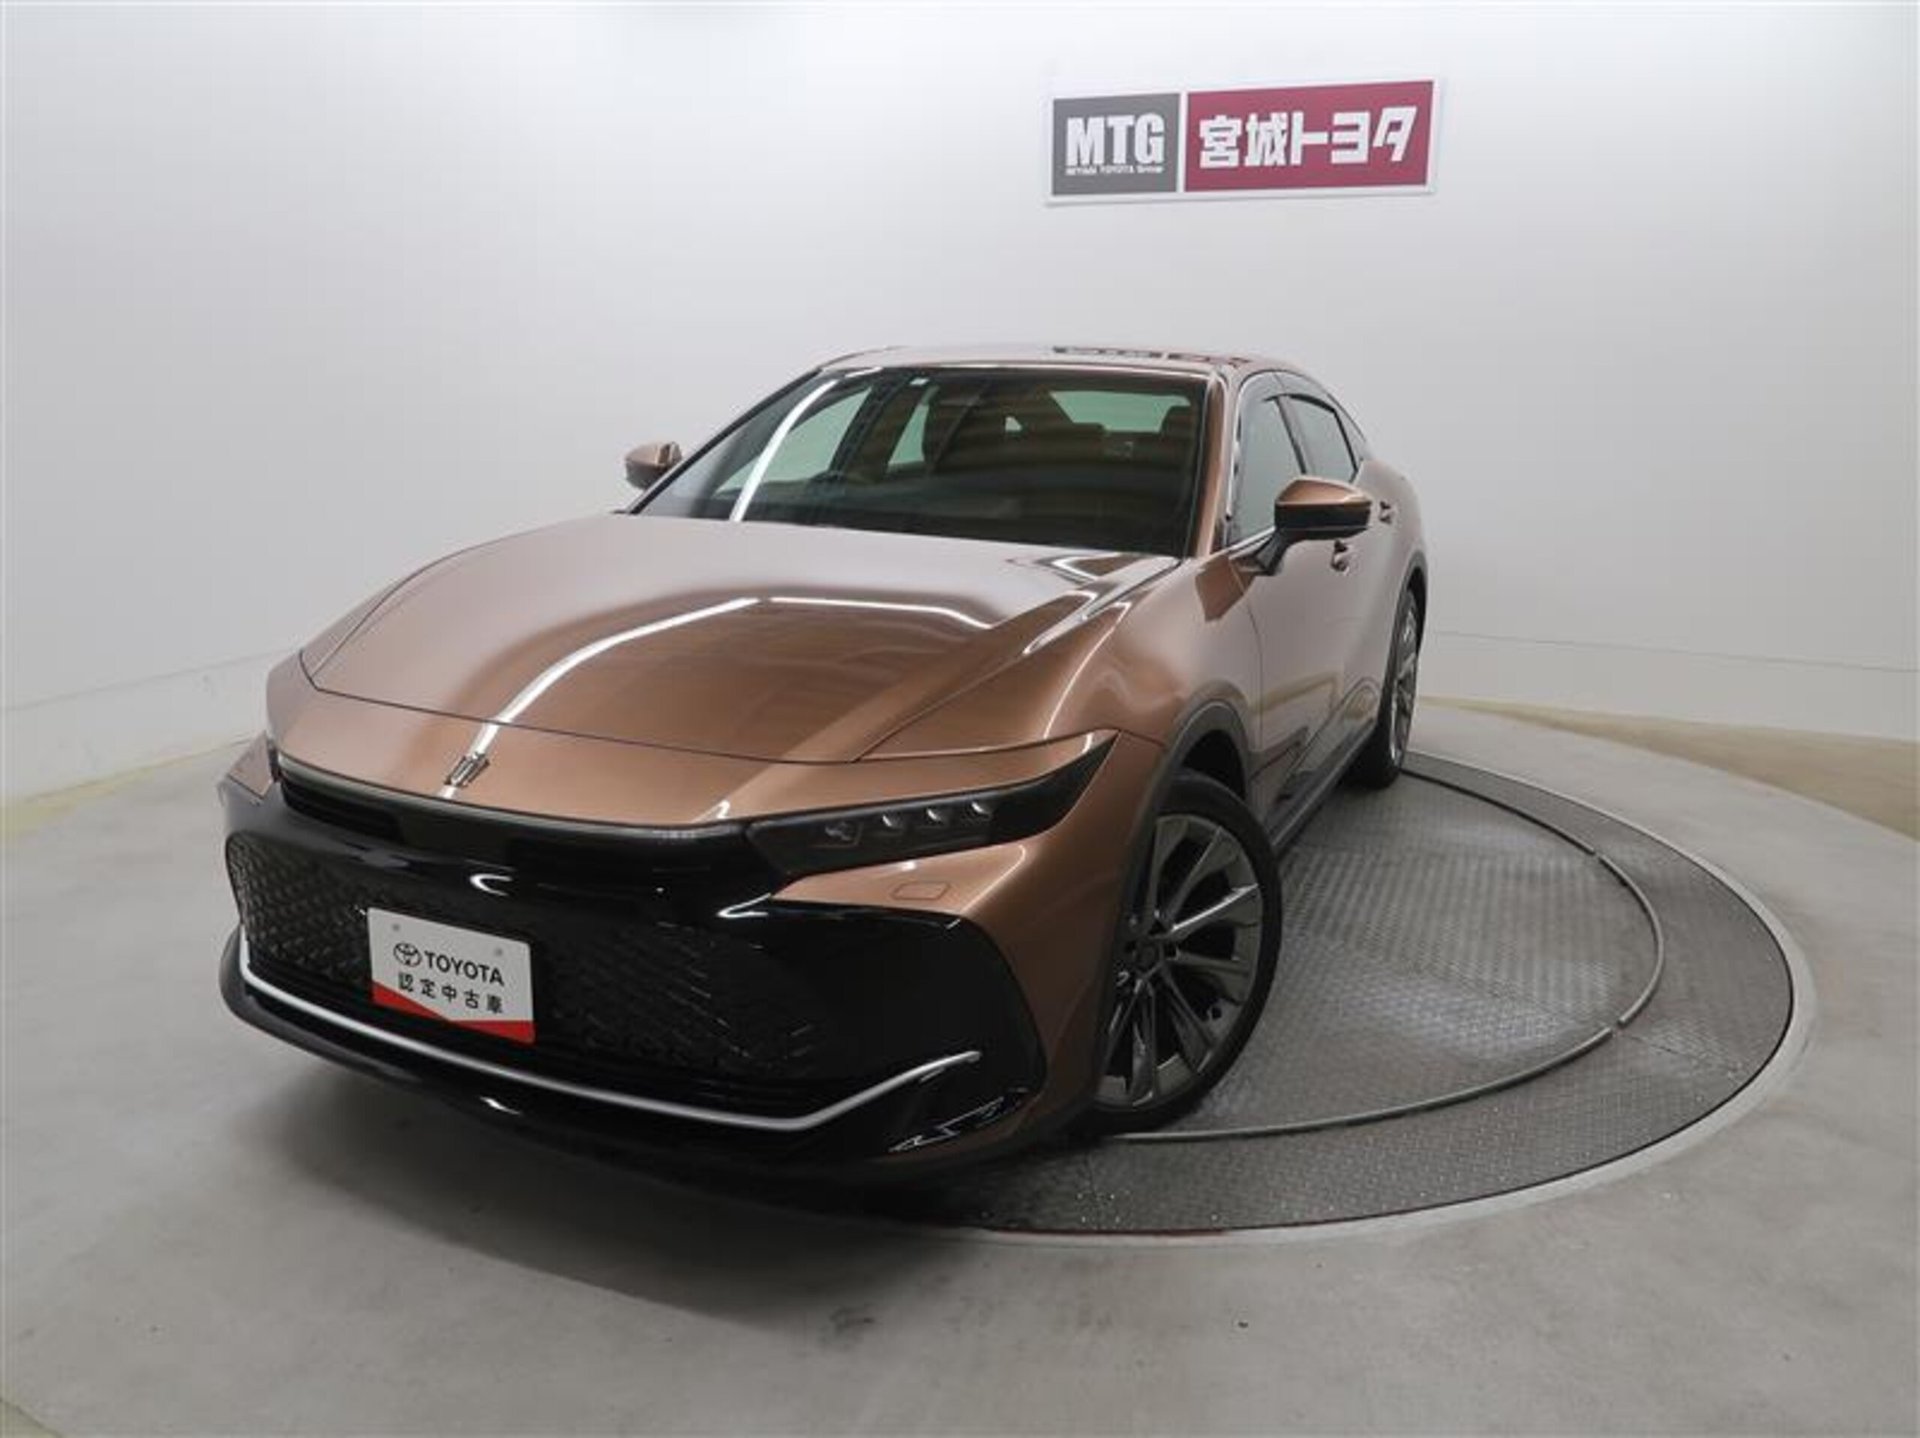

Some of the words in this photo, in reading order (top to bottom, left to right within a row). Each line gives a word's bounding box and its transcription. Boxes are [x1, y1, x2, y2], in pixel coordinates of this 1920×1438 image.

[1066, 112, 1165, 166] MTG
[1199, 105, 1418, 169] 宮城トヨタ
[424, 950, 504, 986] TOYOTA
